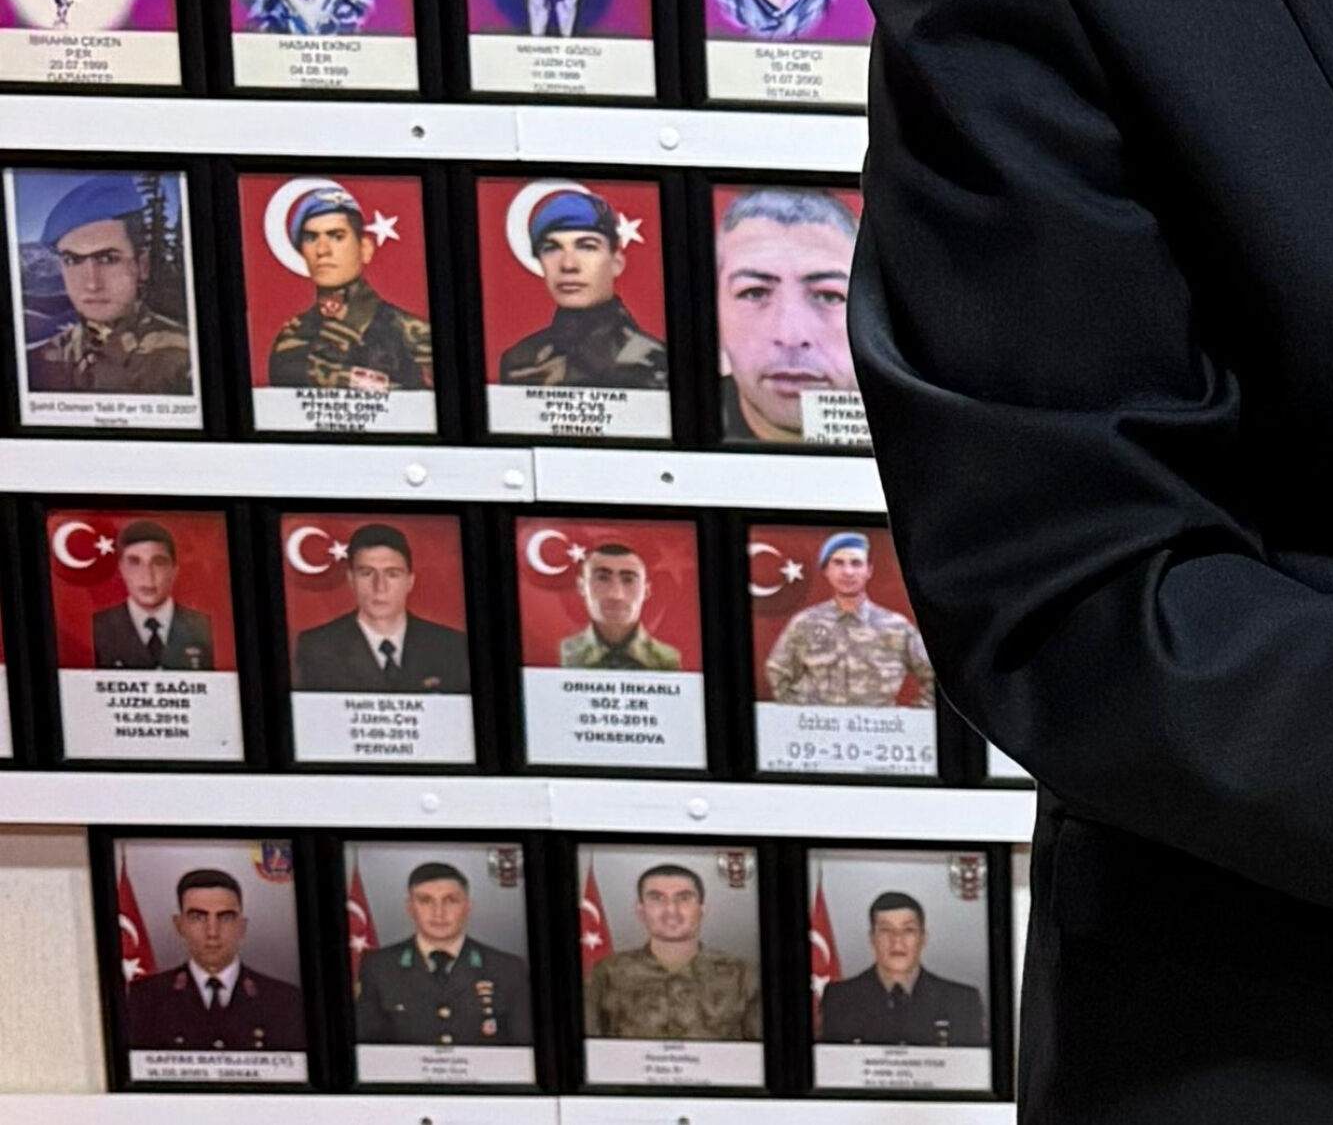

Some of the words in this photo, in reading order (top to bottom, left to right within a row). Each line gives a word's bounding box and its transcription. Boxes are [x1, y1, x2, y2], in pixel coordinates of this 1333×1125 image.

[96, 681, 148, 693] SEDAT
[155, 680, 207, 694] SAĞIR
[563, 682, 616, 693] ORHAN
[788, 742, 933, 764] 09-10-2016
